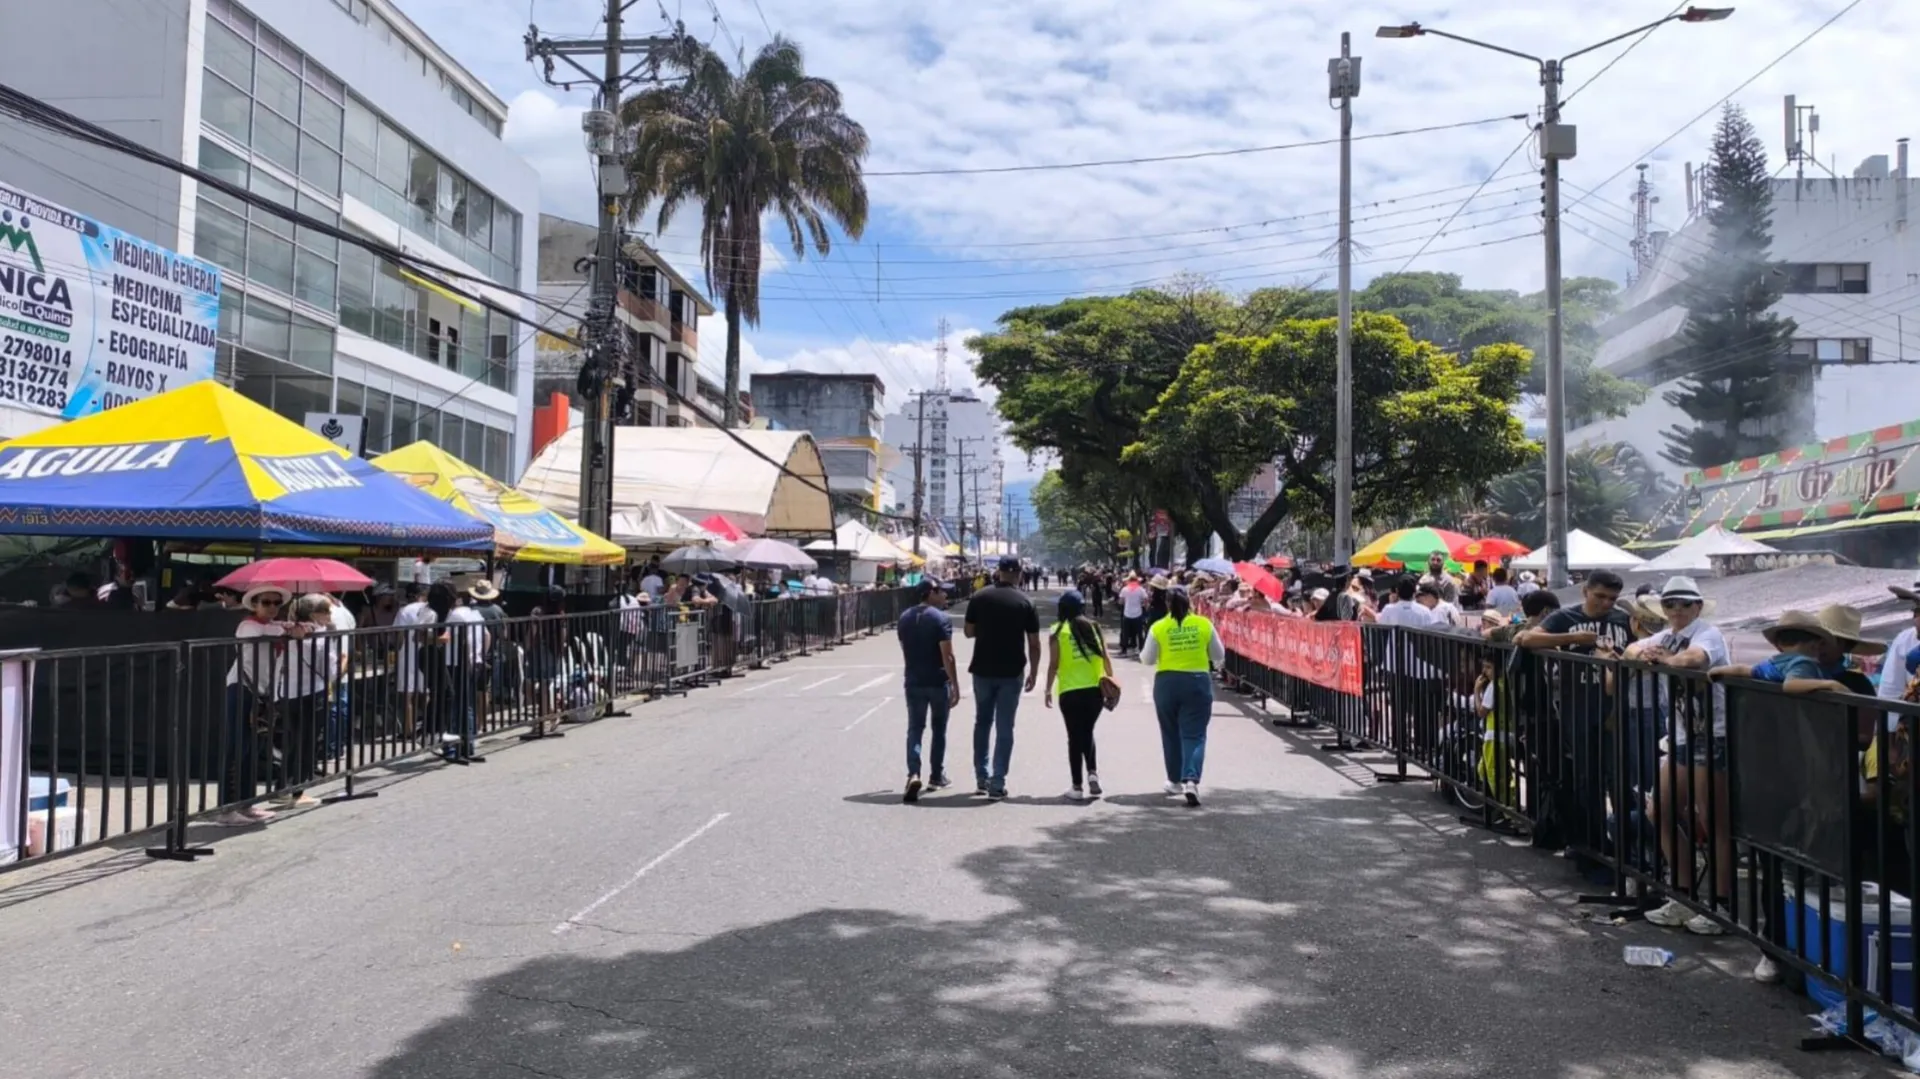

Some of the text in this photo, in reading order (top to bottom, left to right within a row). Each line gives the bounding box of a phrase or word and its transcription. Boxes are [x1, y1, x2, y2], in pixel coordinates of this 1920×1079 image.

[23, 199, 63, 225] PROVIDA
[113, 238, 218, 297] MEDICINA GENERAL
[112, 273, 182, 316] MEDICINA
[34, 305, 71, 326] Quinta
[111, 299, 216, 349] ESPECIALIZADA
[4, 335, 71, 368] 2798014
[109, 330, 188, 371] ECOGRAFÍA
[106, 361, 168, 394] RAYOS X
[0, 440, 188, 479] AGUILA
